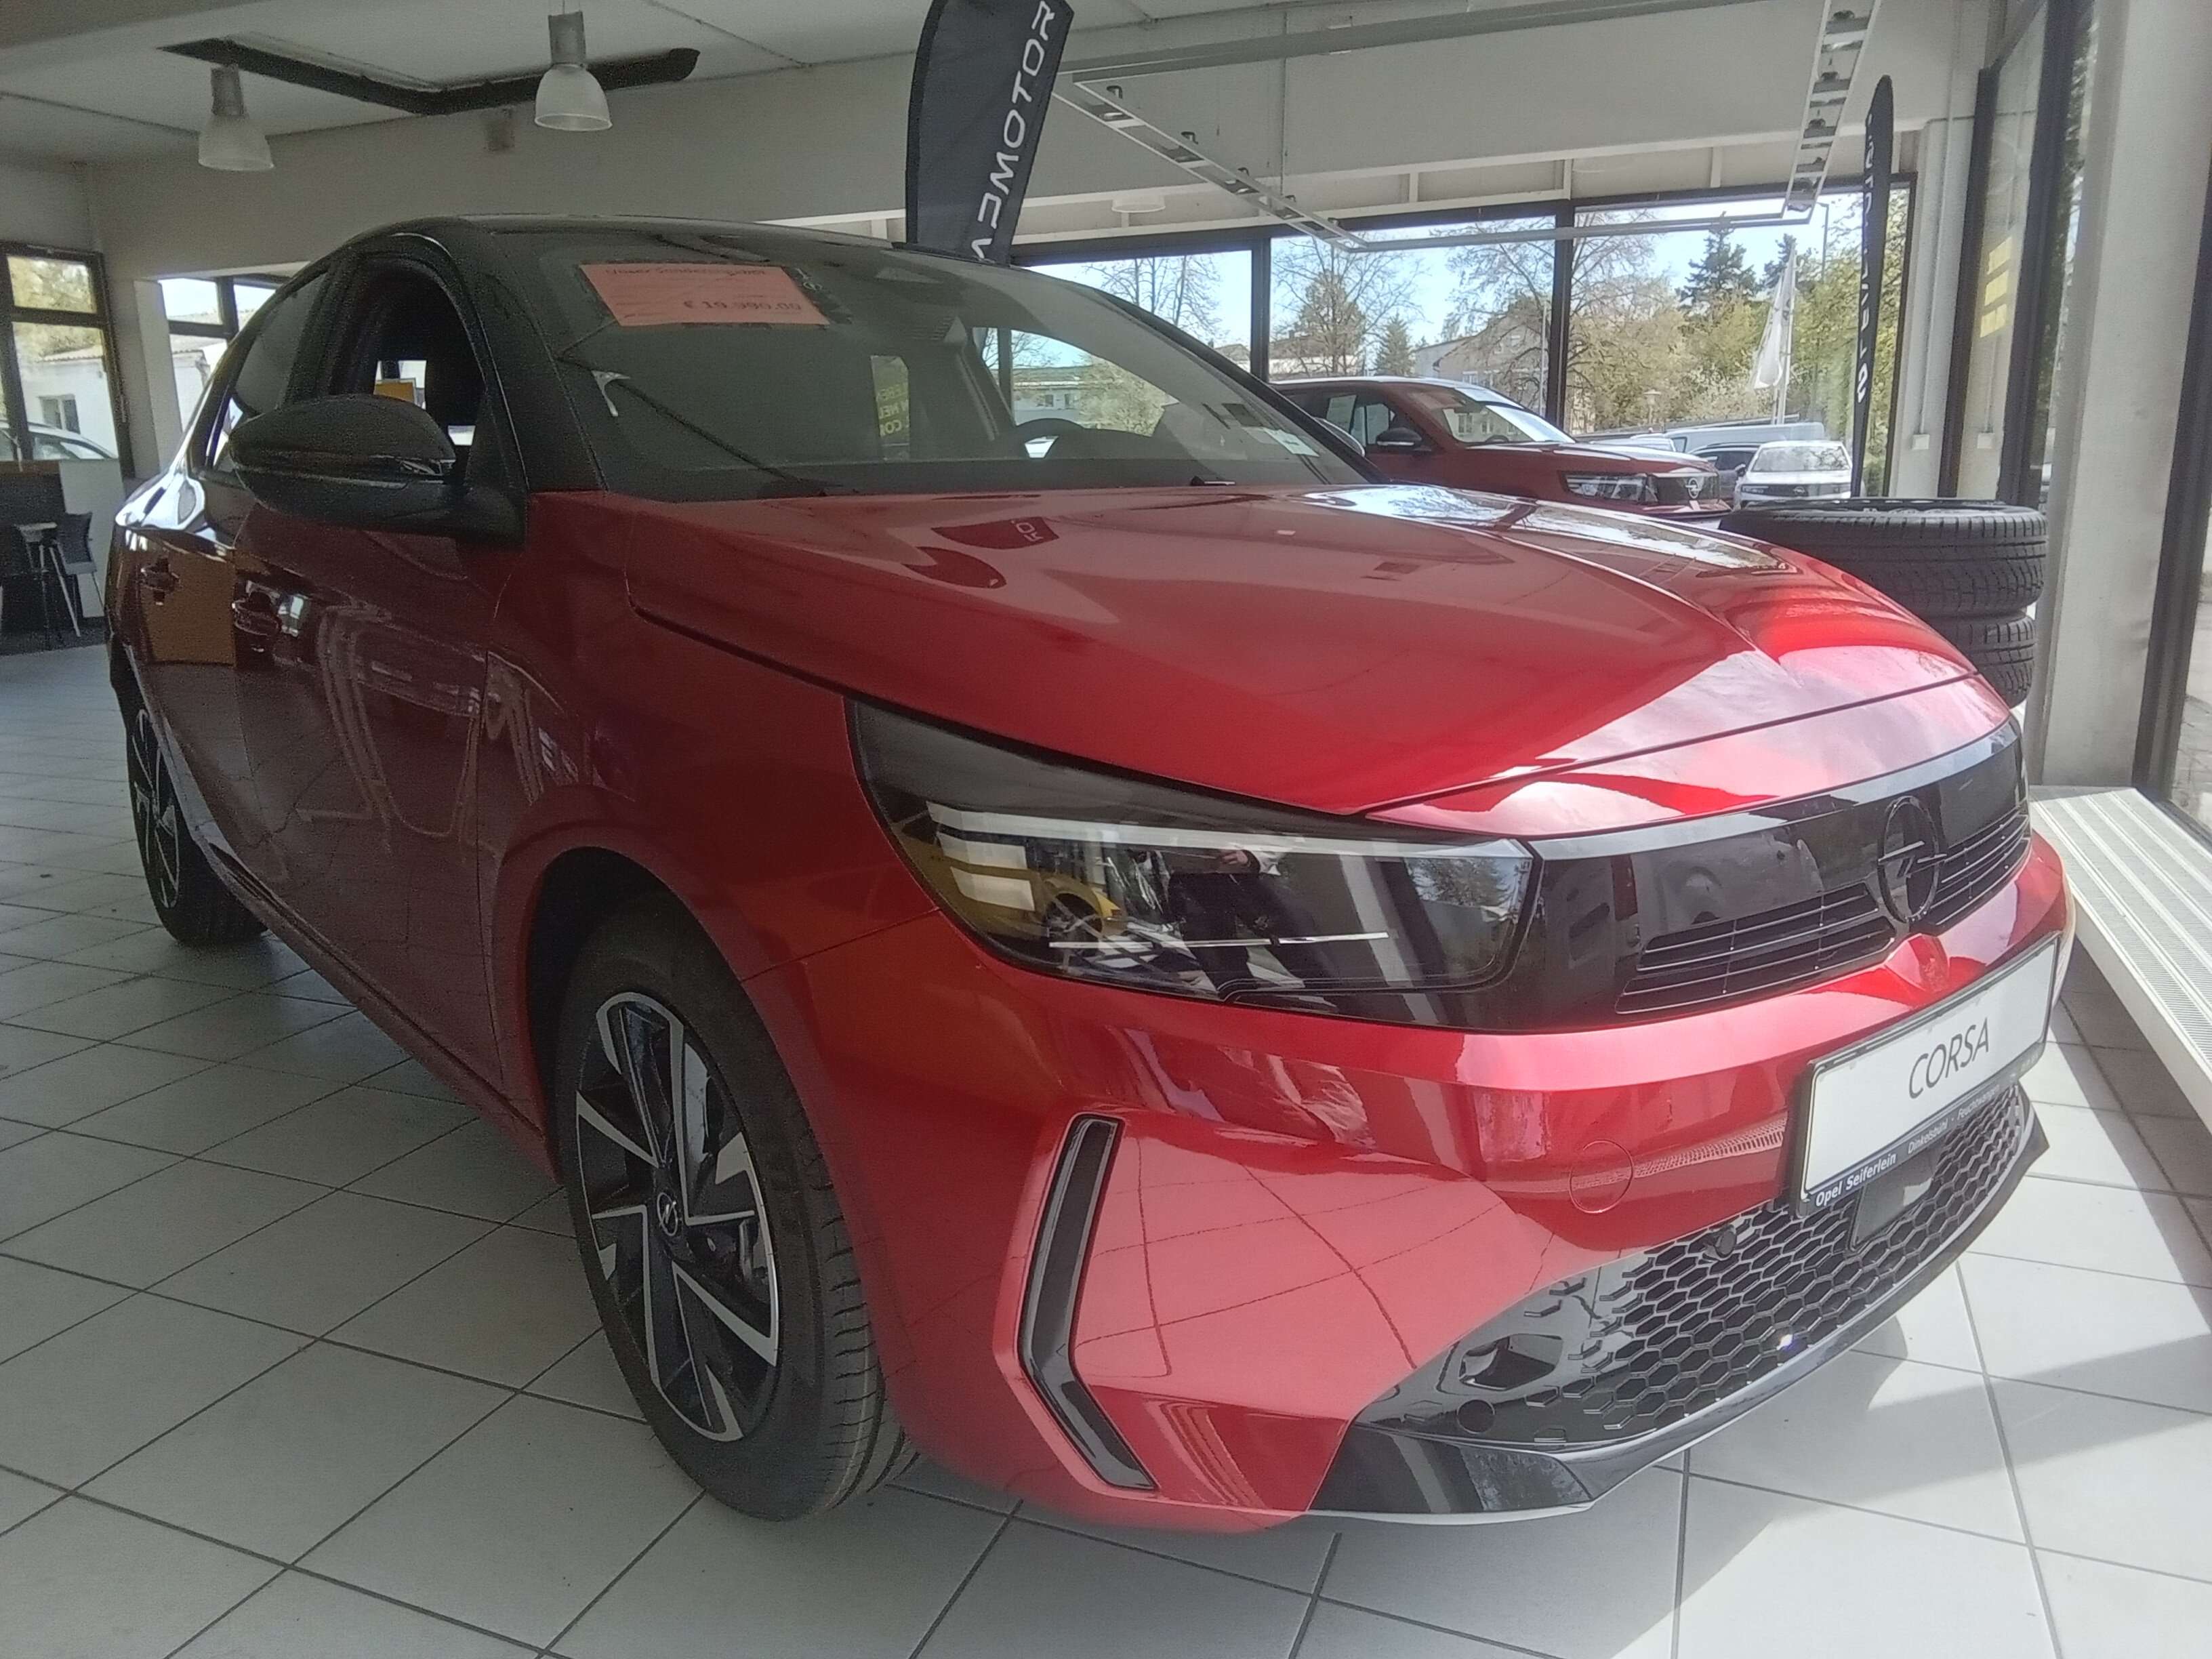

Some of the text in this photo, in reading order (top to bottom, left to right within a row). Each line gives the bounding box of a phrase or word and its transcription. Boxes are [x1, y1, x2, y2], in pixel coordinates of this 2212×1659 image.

[970, 0, 1055, 260] APMOTOR
[1908, 1017, 1990, 1100] CORSA
[1816, 1181, 1843, 1207] Opel
[1845, 1153, 1897, 1191] Seiferlein
